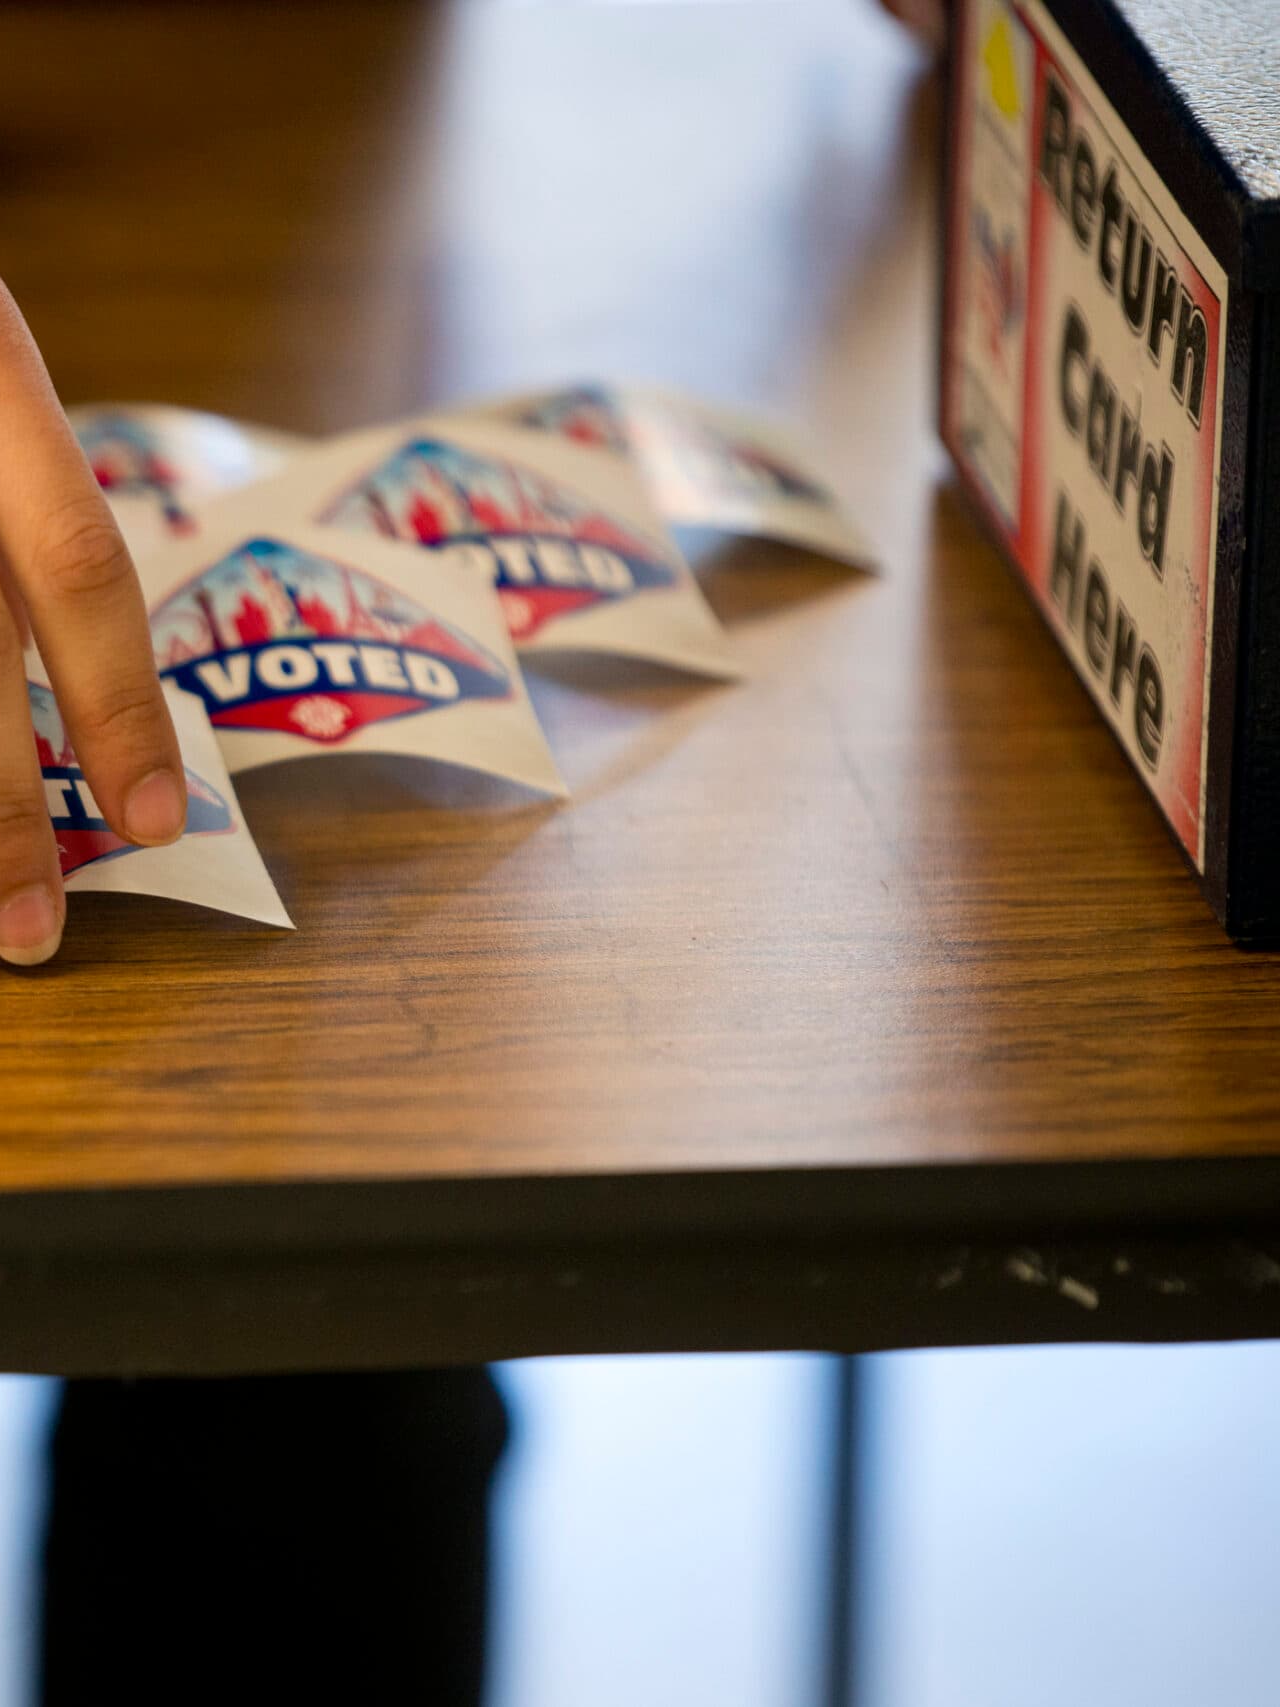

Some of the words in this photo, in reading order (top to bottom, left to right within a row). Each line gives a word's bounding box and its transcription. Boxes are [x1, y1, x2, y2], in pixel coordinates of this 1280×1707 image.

[1041, 66, 1208, 430] Return
[1059, 300, 1175, 583] Card
[197, 643, 460, 702] VOTED
[1050, 488, 1164, 773] Here
